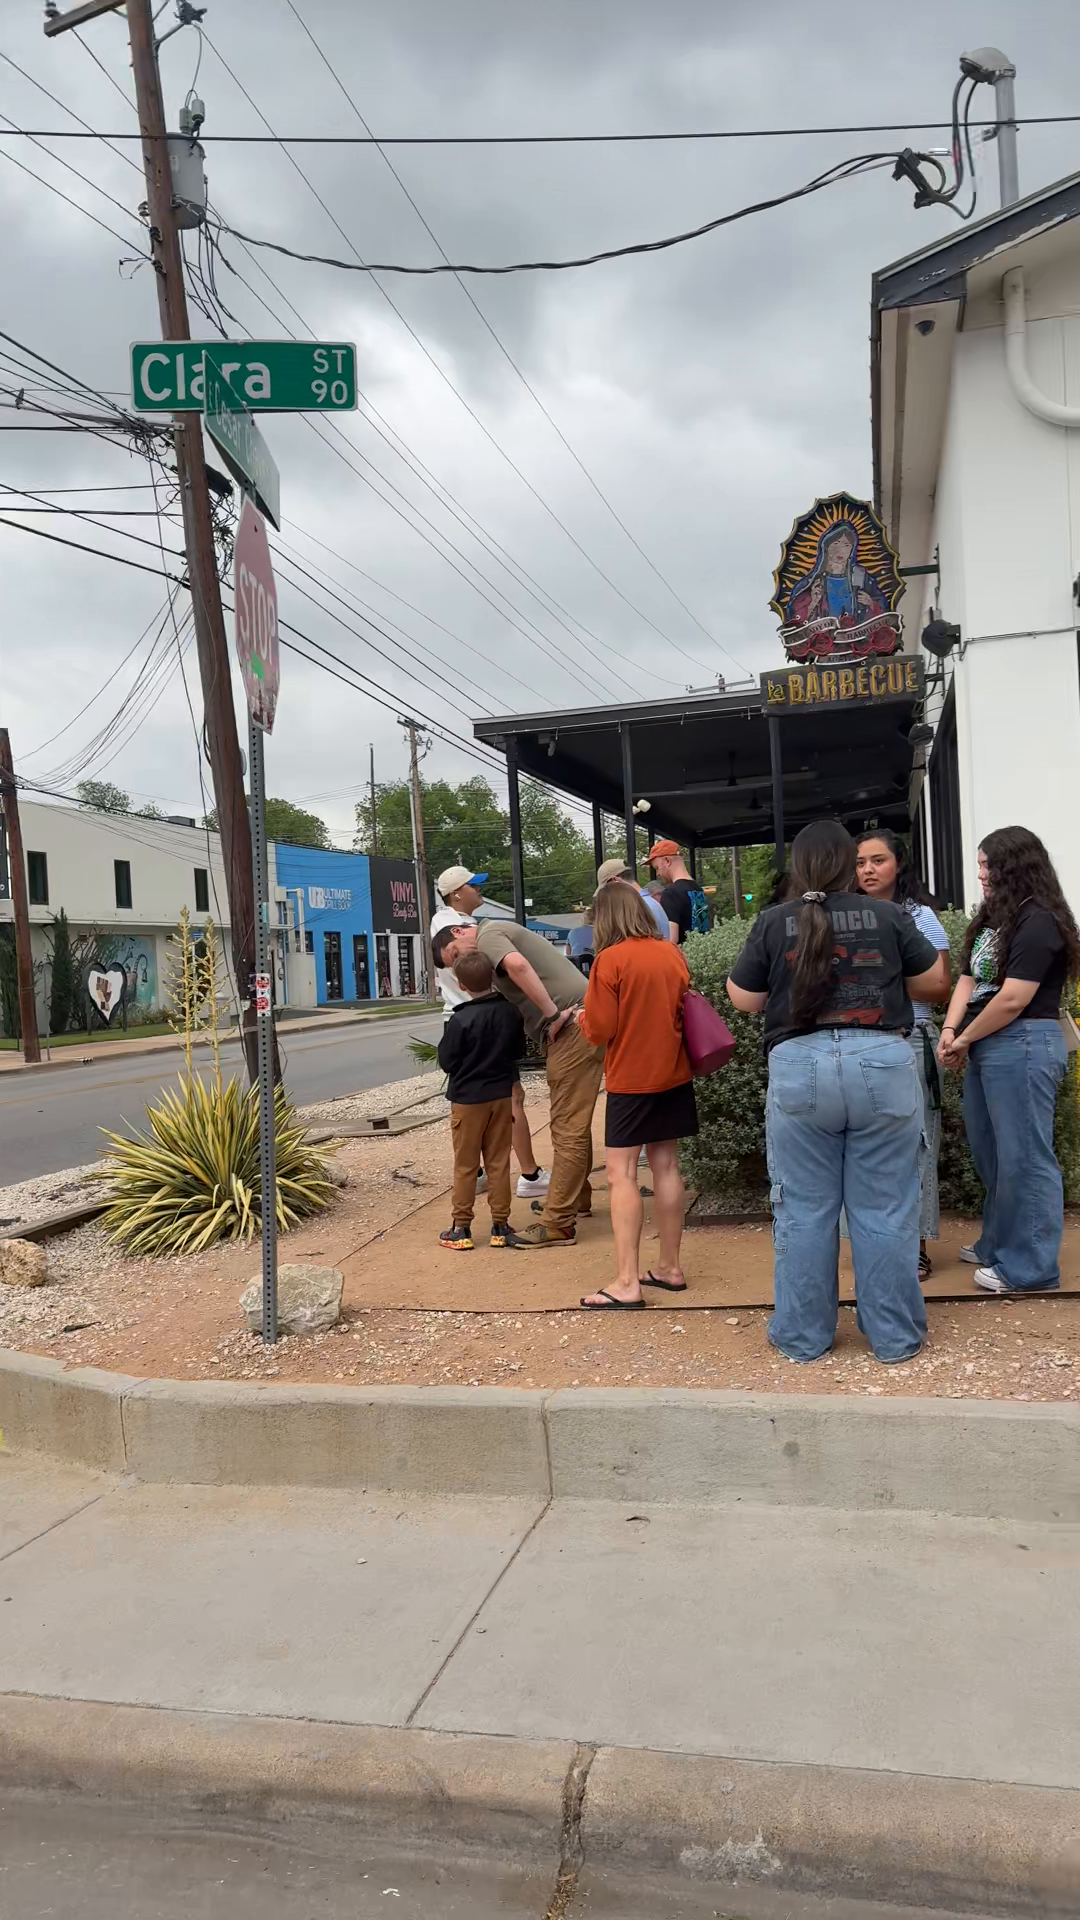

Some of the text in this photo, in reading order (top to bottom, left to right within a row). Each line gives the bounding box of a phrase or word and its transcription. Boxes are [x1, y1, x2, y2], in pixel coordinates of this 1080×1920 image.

[313, 348, 347, 374] ST
[311, 379, 349, 405] 90
[239, 563, 276, 665] STOP
[787, 661, 919, 706] BARBECUE
[324, 889, 351, 900] ULTIMATE
[390, 881, 416, 903] VINYL
